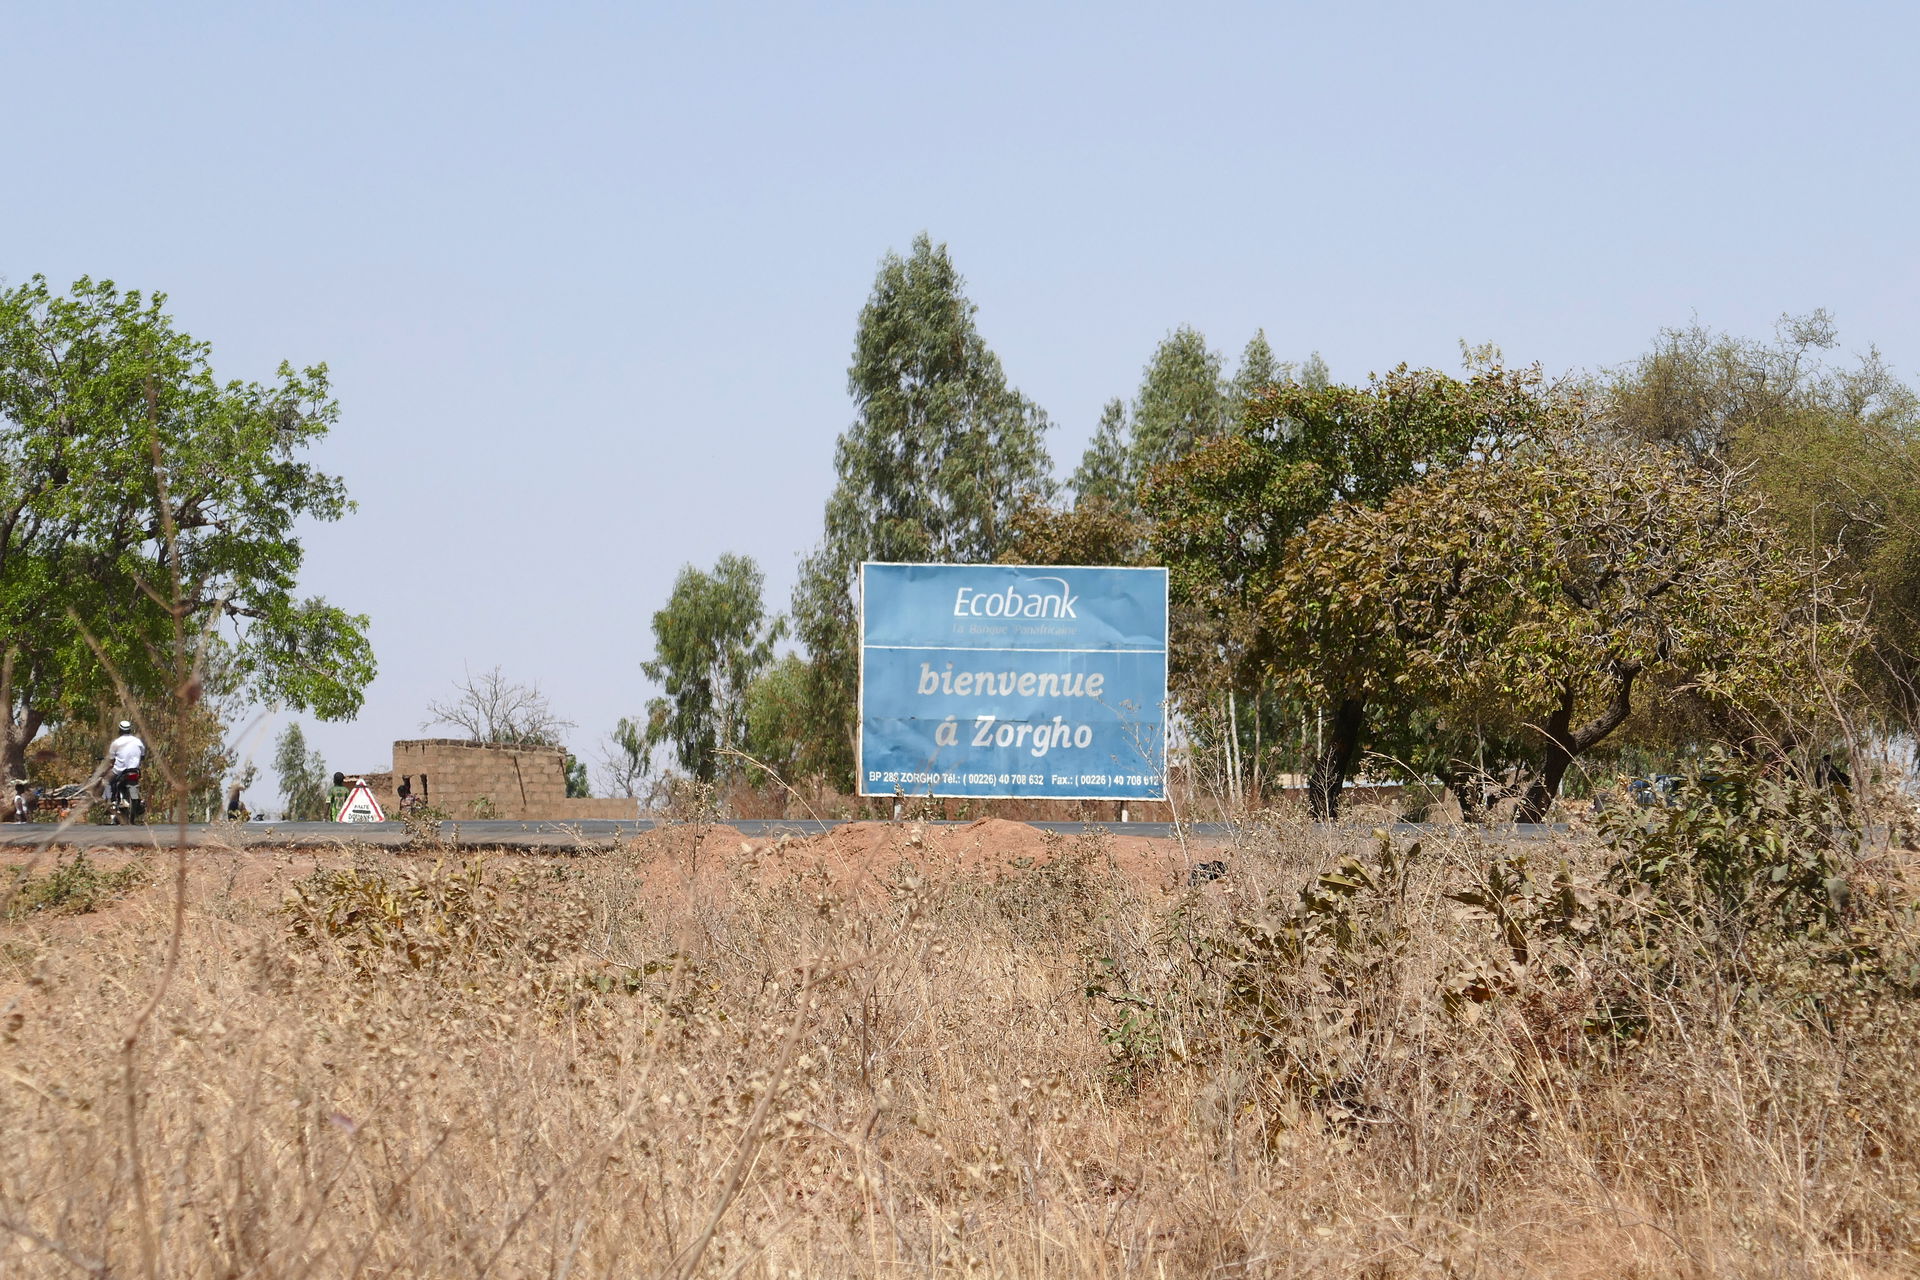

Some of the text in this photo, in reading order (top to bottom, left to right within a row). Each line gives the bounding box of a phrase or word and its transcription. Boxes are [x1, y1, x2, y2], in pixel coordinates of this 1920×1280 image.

[953, 577, 1079, 618] Ecobank
[917, 661, 1104, 697] bienvenue
[971, 715, 1093, 757] Zorgho
[869, 771, 882, 781] BP
[900, 772, 940, 783] ZORGHO
[999, 774, 1009, 784] 40
[1011, 774, 1027, 785] 708
[1029, 775, 1044, 785] 632
[1114, 776, 1124, 785] 40
[1126, 776, 1142, 786] 708
